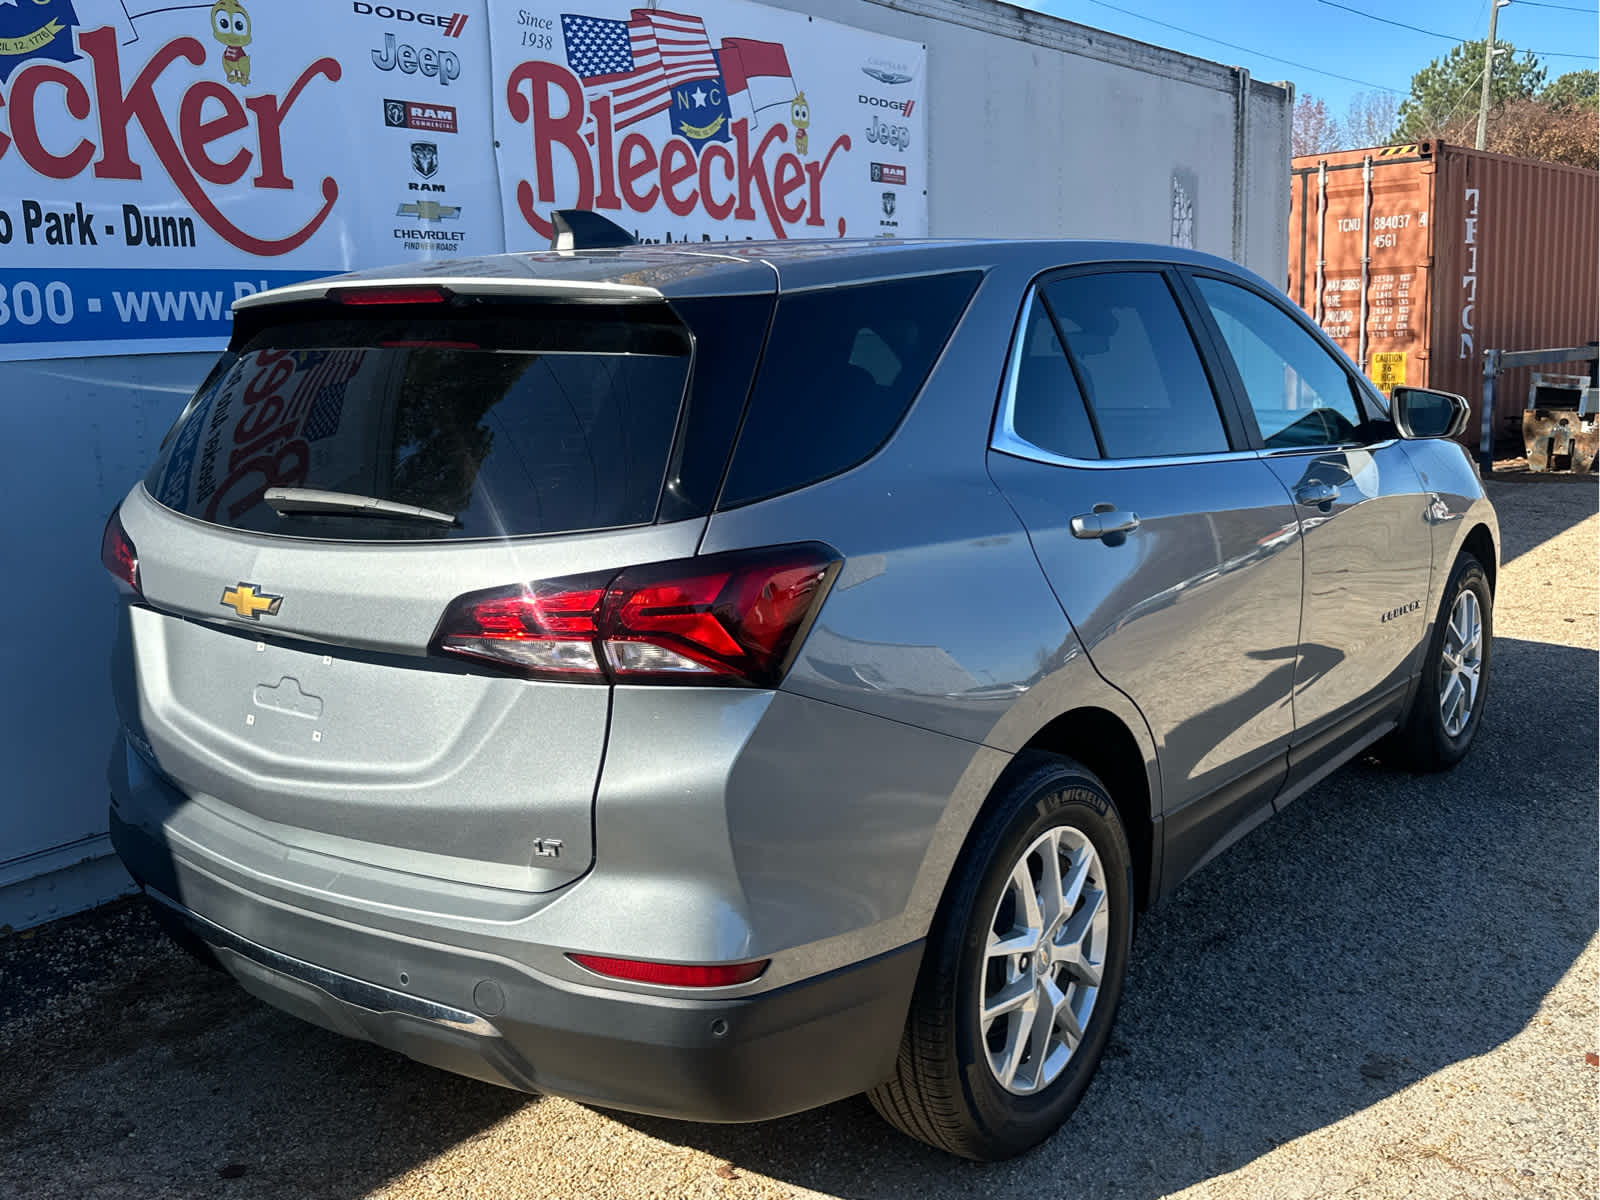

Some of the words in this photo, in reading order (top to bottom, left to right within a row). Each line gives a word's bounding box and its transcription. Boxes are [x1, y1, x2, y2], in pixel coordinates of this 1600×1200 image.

[353, 2, 452, 29] DODGE
[517, 9, 553, 30] Since
[28, 30, 50, 46] 1776
[520, 31, 553, 50] 1938
[371, 32, 461, 86] Jeep
[676, 91, 690, 110] N
[709, 88, 721, 106] C
[858, 95, 906, 112] DODGE
[410, 107, 453, 120] RAM
[0, 26, 342, 257] cker
[865, 115, 910, 152] Jeep
[506, 60, 851, 239] Bleecker
[408, 182, 446, 193] RAM
[22, 200, 98, 246] Park
[122, 203, 196, 247] Dunn
[1337, 218, 1361, 233] TCNU
[1374, 214, 1411, 231] 884037
[393, 229, 466, 241] CHEVROLET
[1373, 233, 1397, 248] 45G1
[1375, 354, 1403, 363] CAUTION
[1063, 789, 1108, 812] MICHELIN
[533, 838, 563, 857] LT
